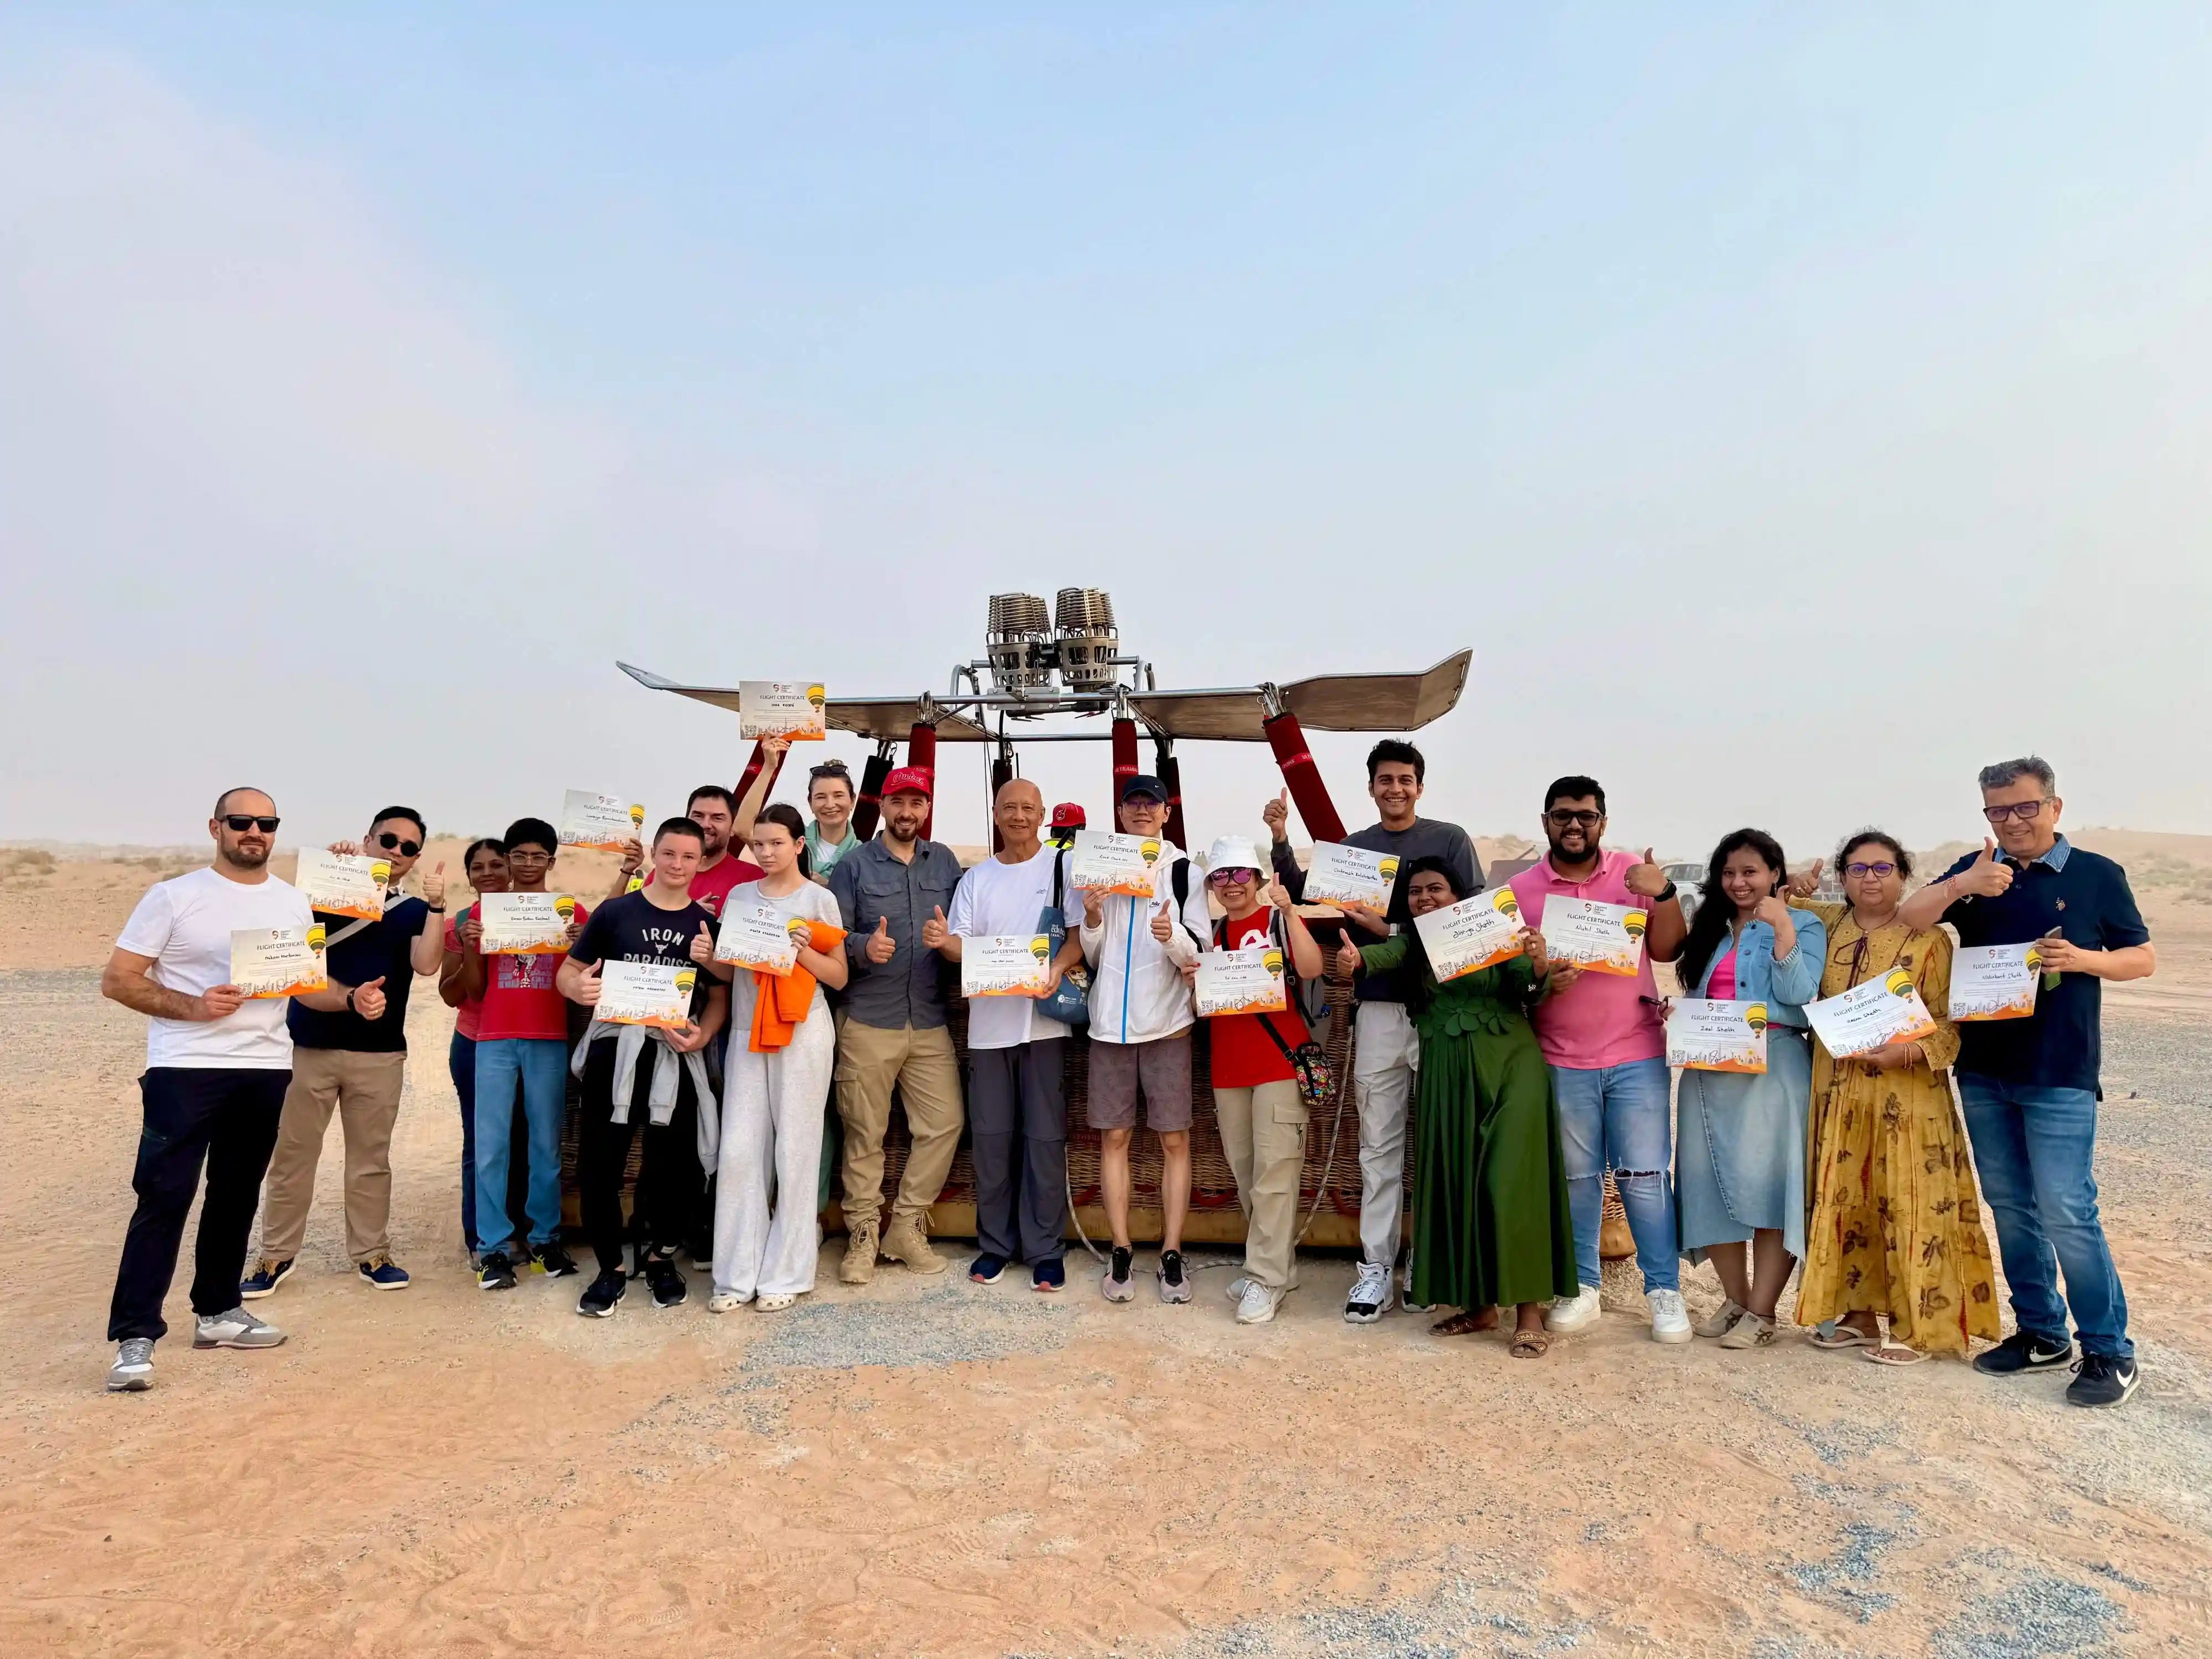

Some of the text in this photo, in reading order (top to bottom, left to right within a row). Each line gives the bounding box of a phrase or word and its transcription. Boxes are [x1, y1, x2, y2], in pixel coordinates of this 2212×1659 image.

[600, 807, 628, 816] CERTIFICATE
[339, 866, 369, 876] CERTIFICATE
[1348, 861, 1377, 871] CERTIFICATE
[743, 917, 785, 931] FLIGHT CERTIFICATE
[1442, 908, 1494, 930] FLIGHT CERTIFICATE
[1586, 916, 1620, 926] CERTIFICATE
[642, 928, 684, 945] IRON
[276, 941, 305, 949] CERTIFICATE
[1834, 1007, 1853, 1017] FLIGHT
[1854, 992, 1888, 1009] CERTIFICATE
